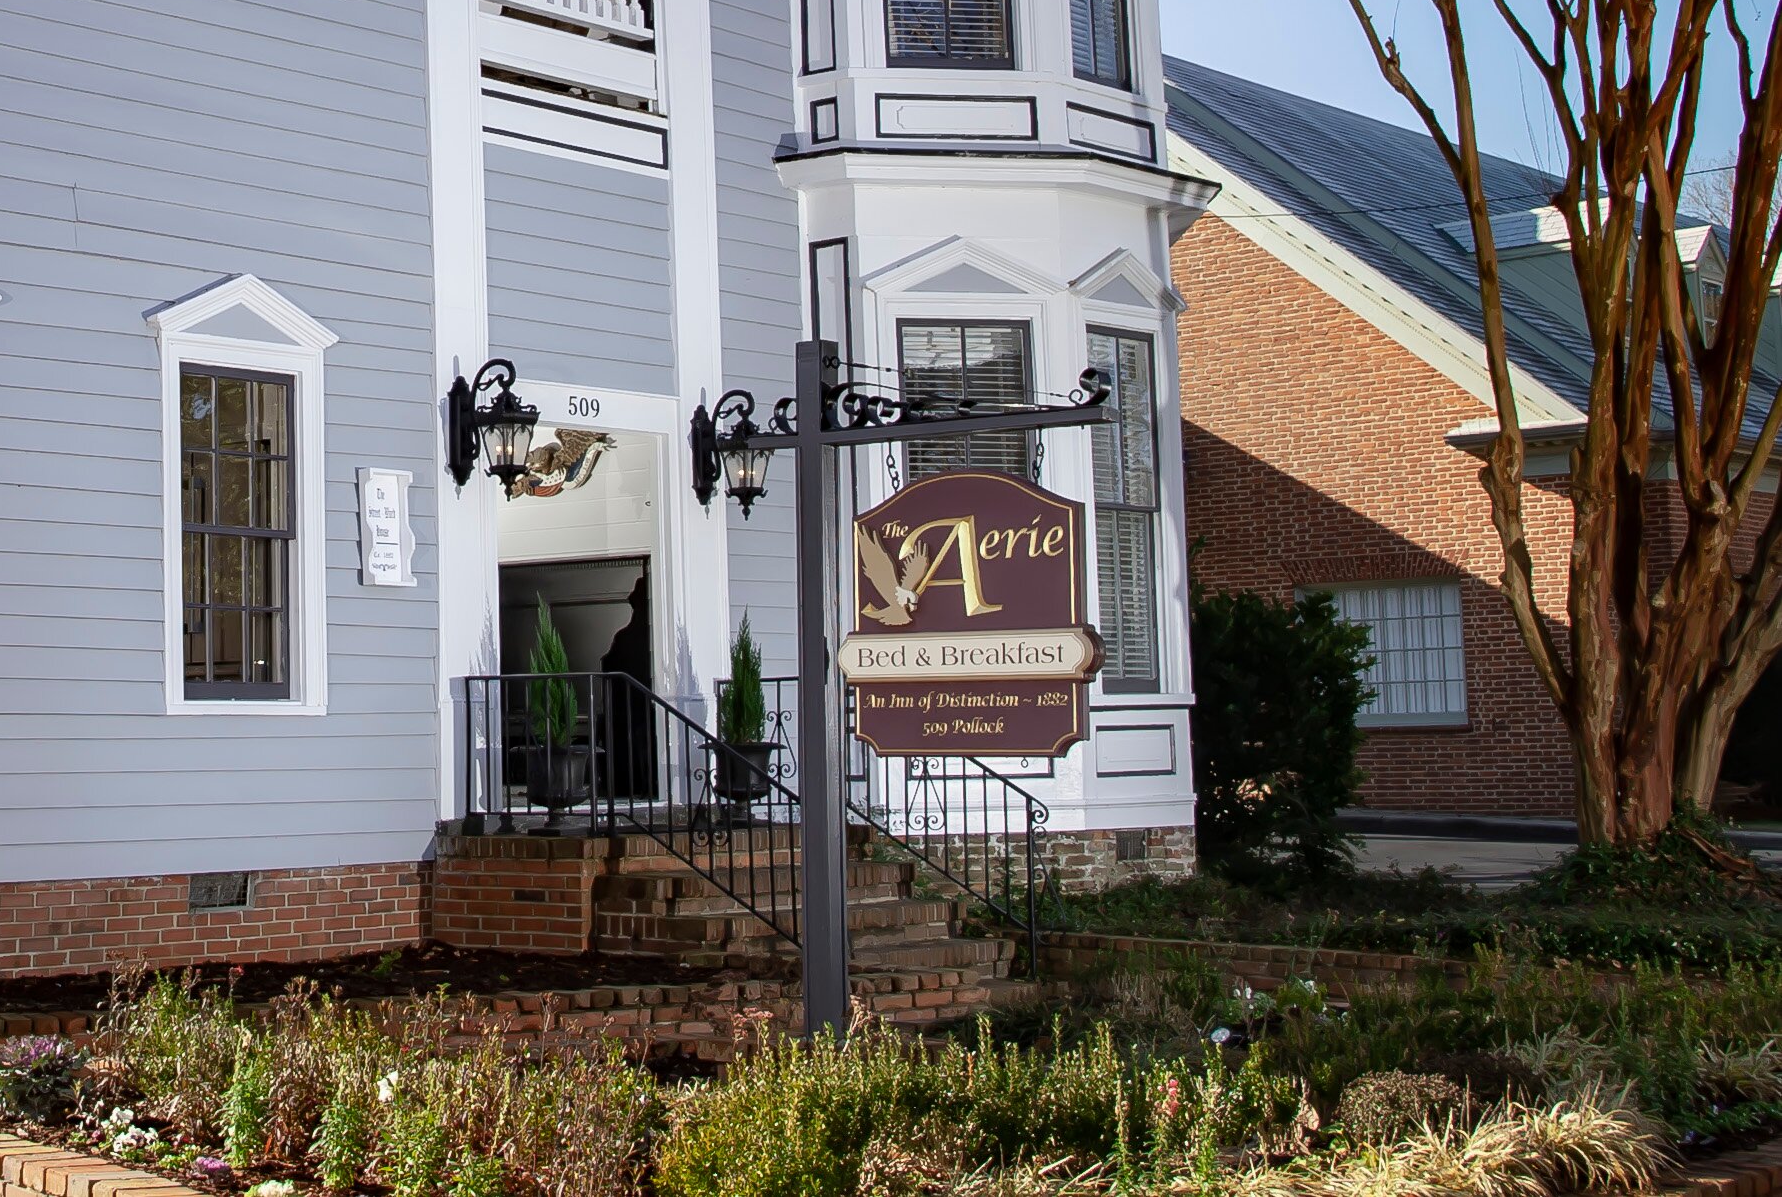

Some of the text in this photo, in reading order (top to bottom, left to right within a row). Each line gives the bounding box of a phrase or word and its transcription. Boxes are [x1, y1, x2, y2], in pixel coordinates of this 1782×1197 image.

[568, 395, 600, 418] 509
[881, 513, 1064, 617] The Aerie
[857, 641, 1064, 668] Bed & Breakfast
[863, 693, 885, 709] An
[889, 693, 914, 708] Inn
[918, 691, 935, 713] of
[936, 692, 1019, 708] Distinction
[1036, 692, 1068, 707] 1882
[922, 716, 1004, 737] 509 Pollock
